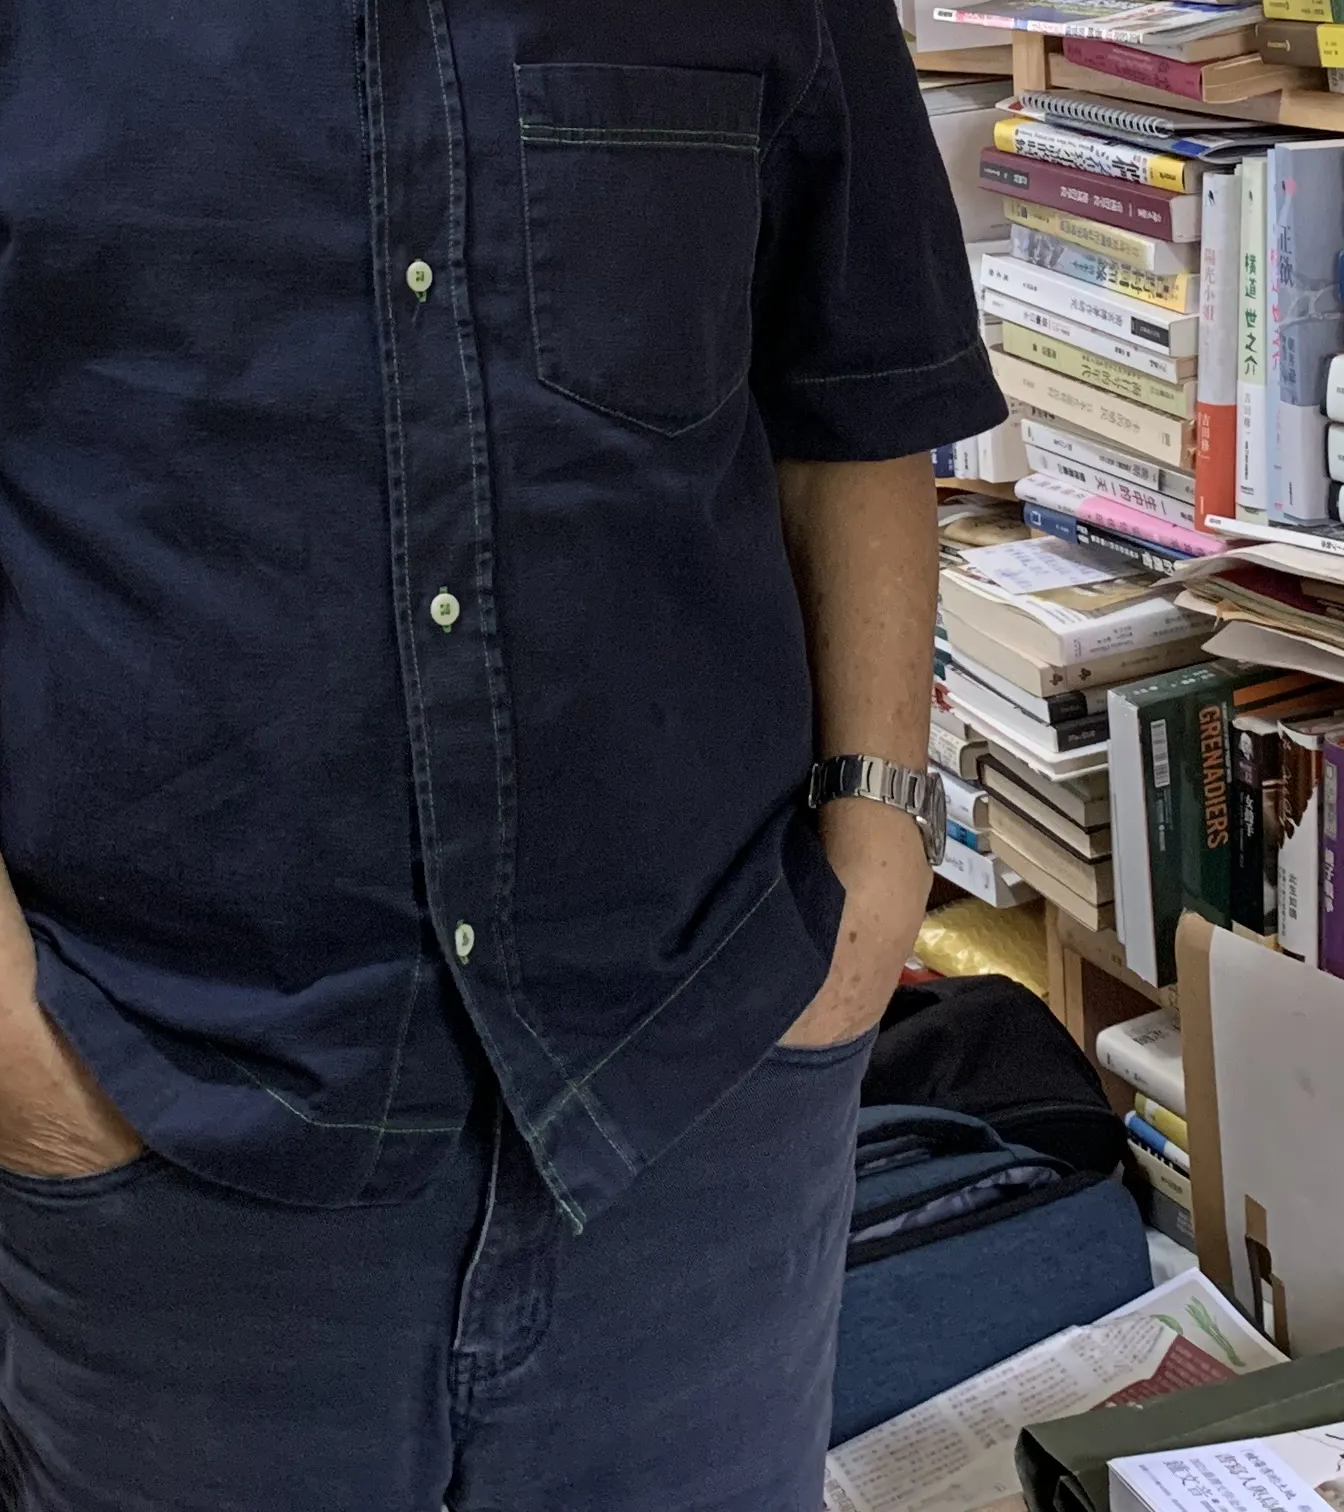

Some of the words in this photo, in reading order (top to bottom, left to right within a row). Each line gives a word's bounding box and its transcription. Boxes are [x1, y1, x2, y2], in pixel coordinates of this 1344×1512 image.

[1242, 253, 1259, 377] 橫道世之介
[1277, 224, 1295, 287] 正欲
[1198, 704, 1229, 849] GRENADIERS
